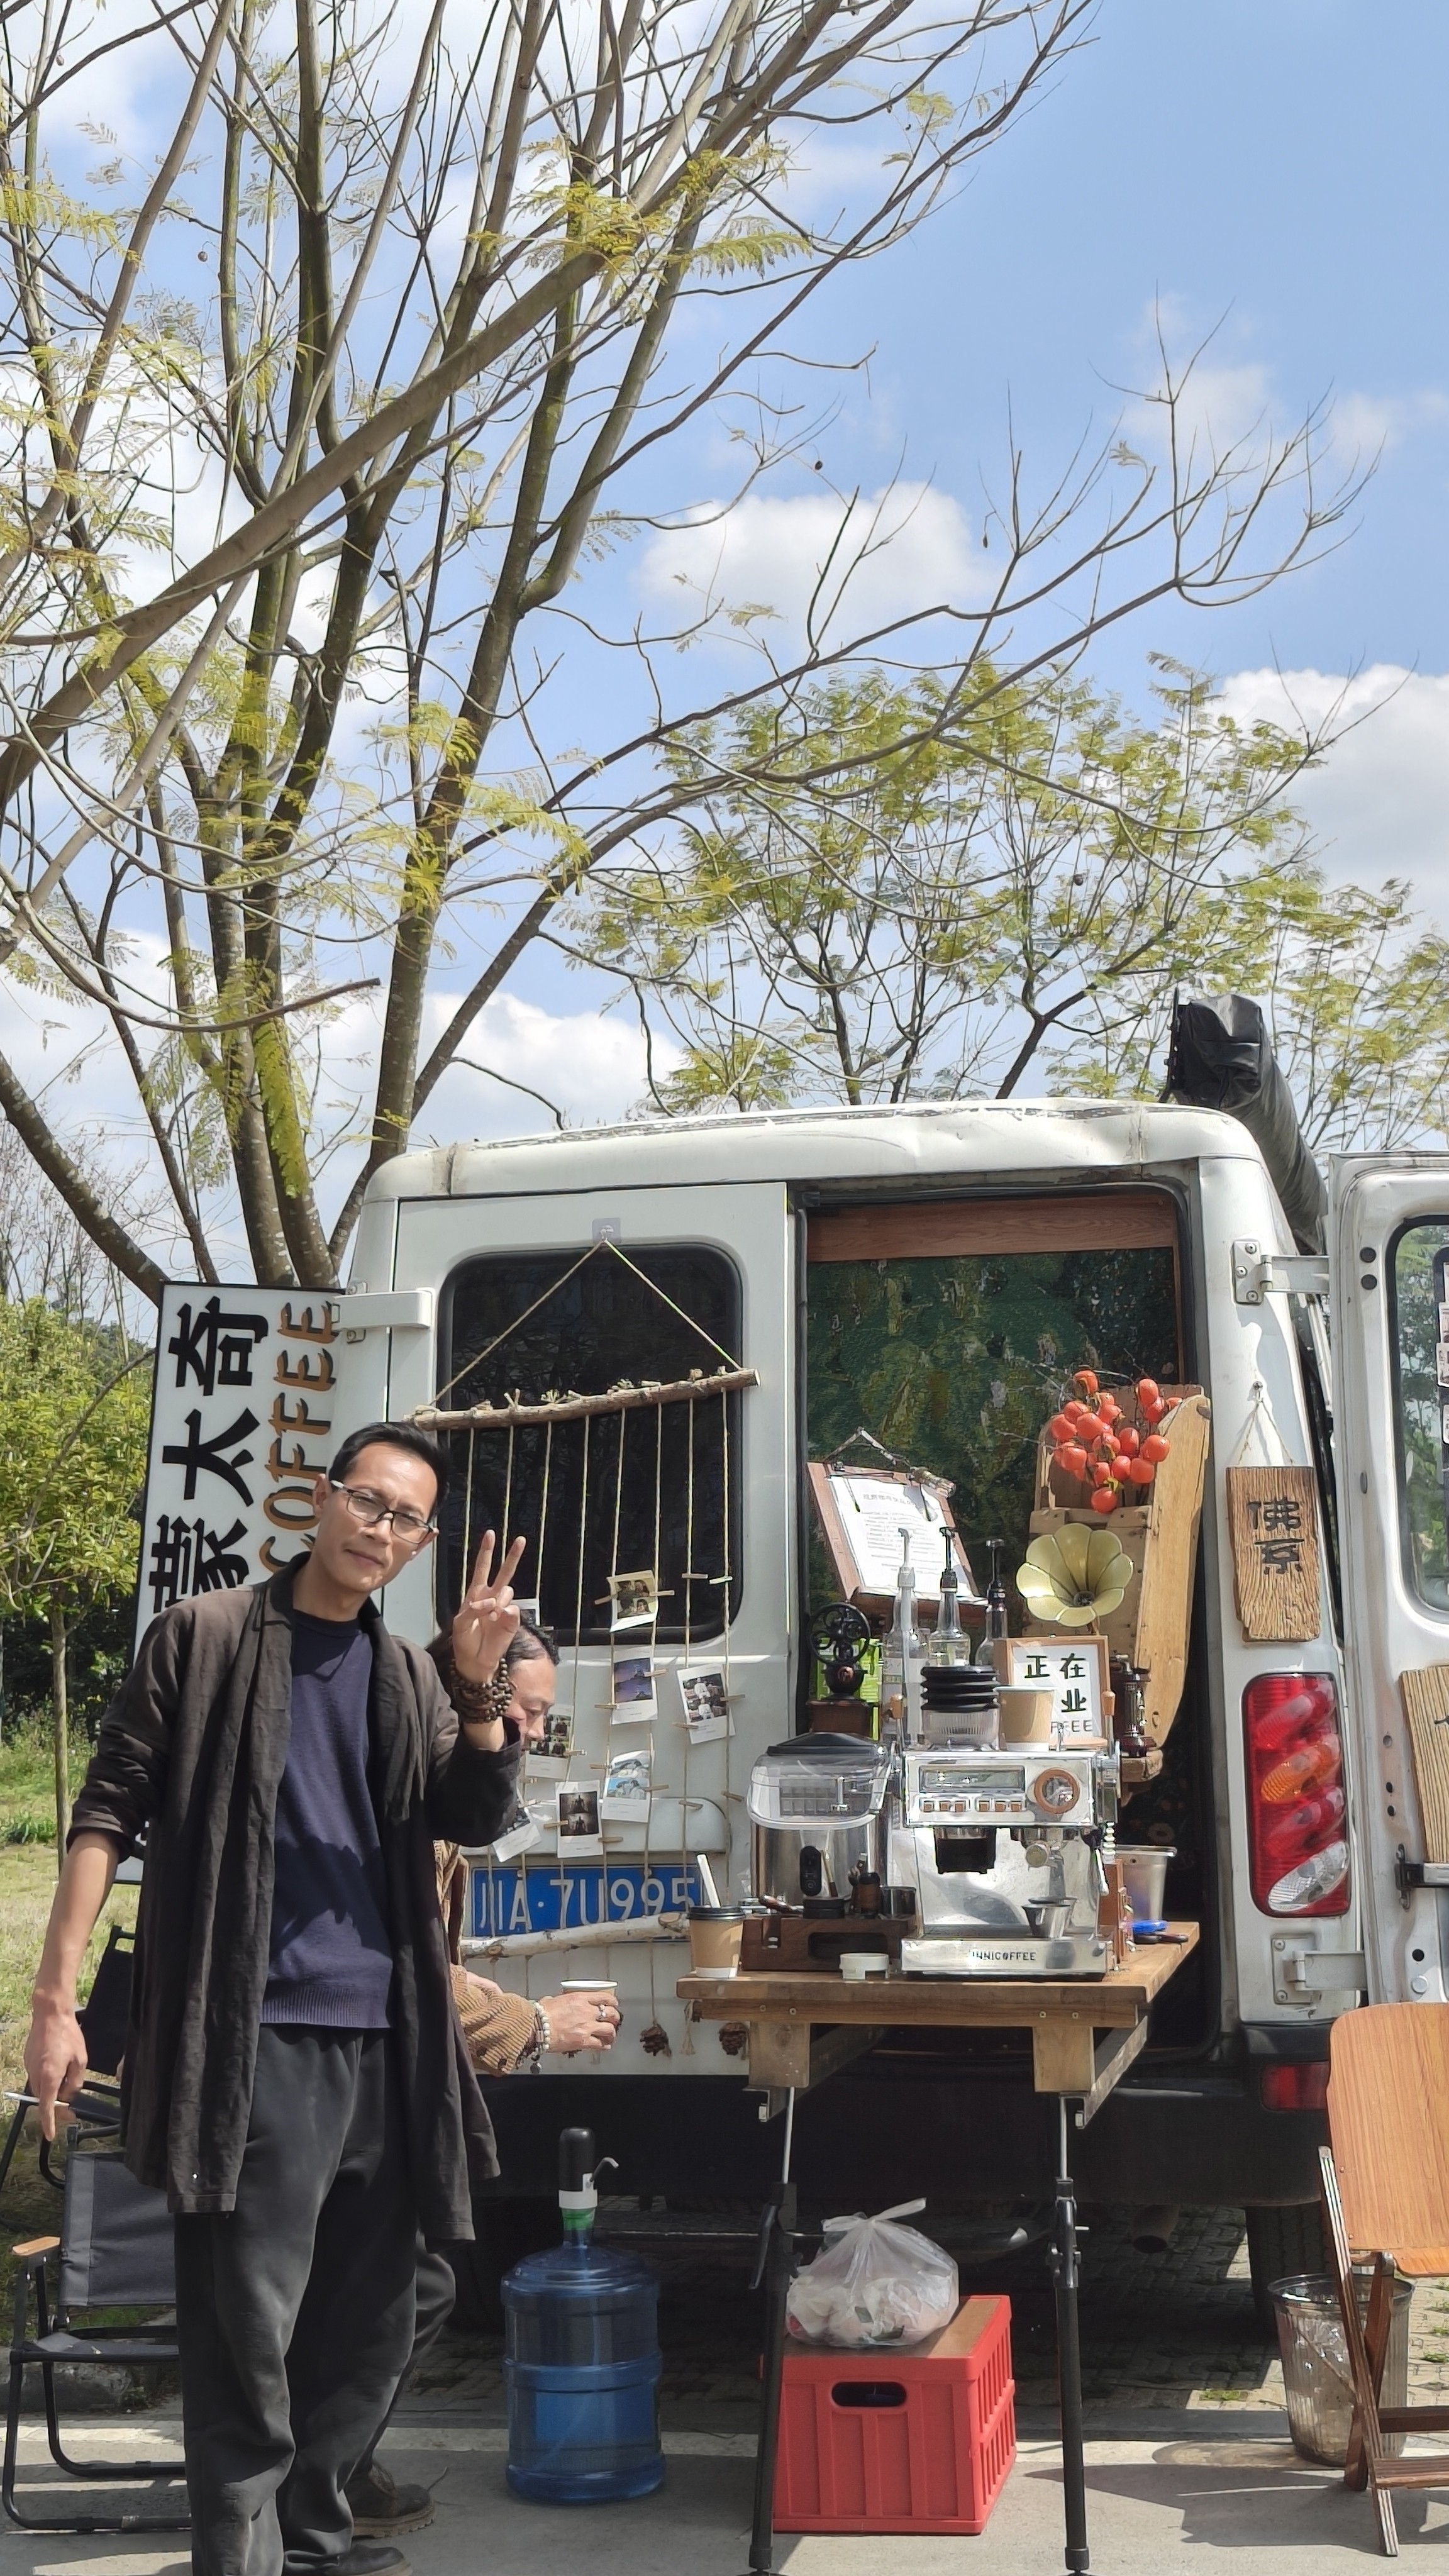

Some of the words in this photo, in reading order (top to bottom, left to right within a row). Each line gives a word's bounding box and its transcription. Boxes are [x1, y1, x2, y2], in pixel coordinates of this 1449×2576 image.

[258, 1299, 338, 1574] COFFEE
[1024, 1652, 1087, 1679] 正在
[1061, 1688, 1087, 1713] 业
